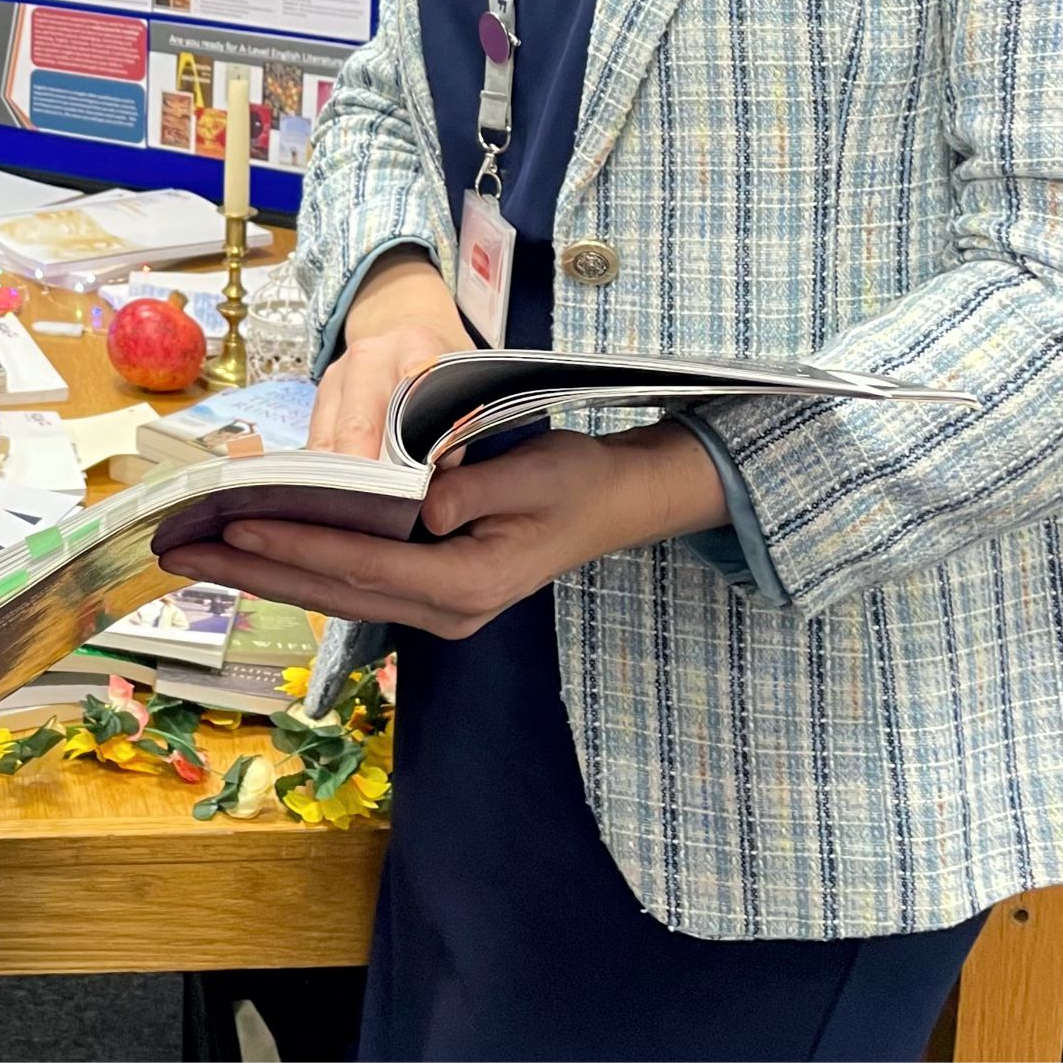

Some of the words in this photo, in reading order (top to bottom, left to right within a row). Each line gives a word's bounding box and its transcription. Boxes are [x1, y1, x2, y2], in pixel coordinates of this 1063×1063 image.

[169, 34, 184, 44] Are
[184, 37, 200, 48] you
[201, 38, 225, 52] ready
[225, 41, 238, 51] for
[238, 43, 247, 53] A
[248, 44, 270, 58] Level
[271, 48, 301, 62] English
